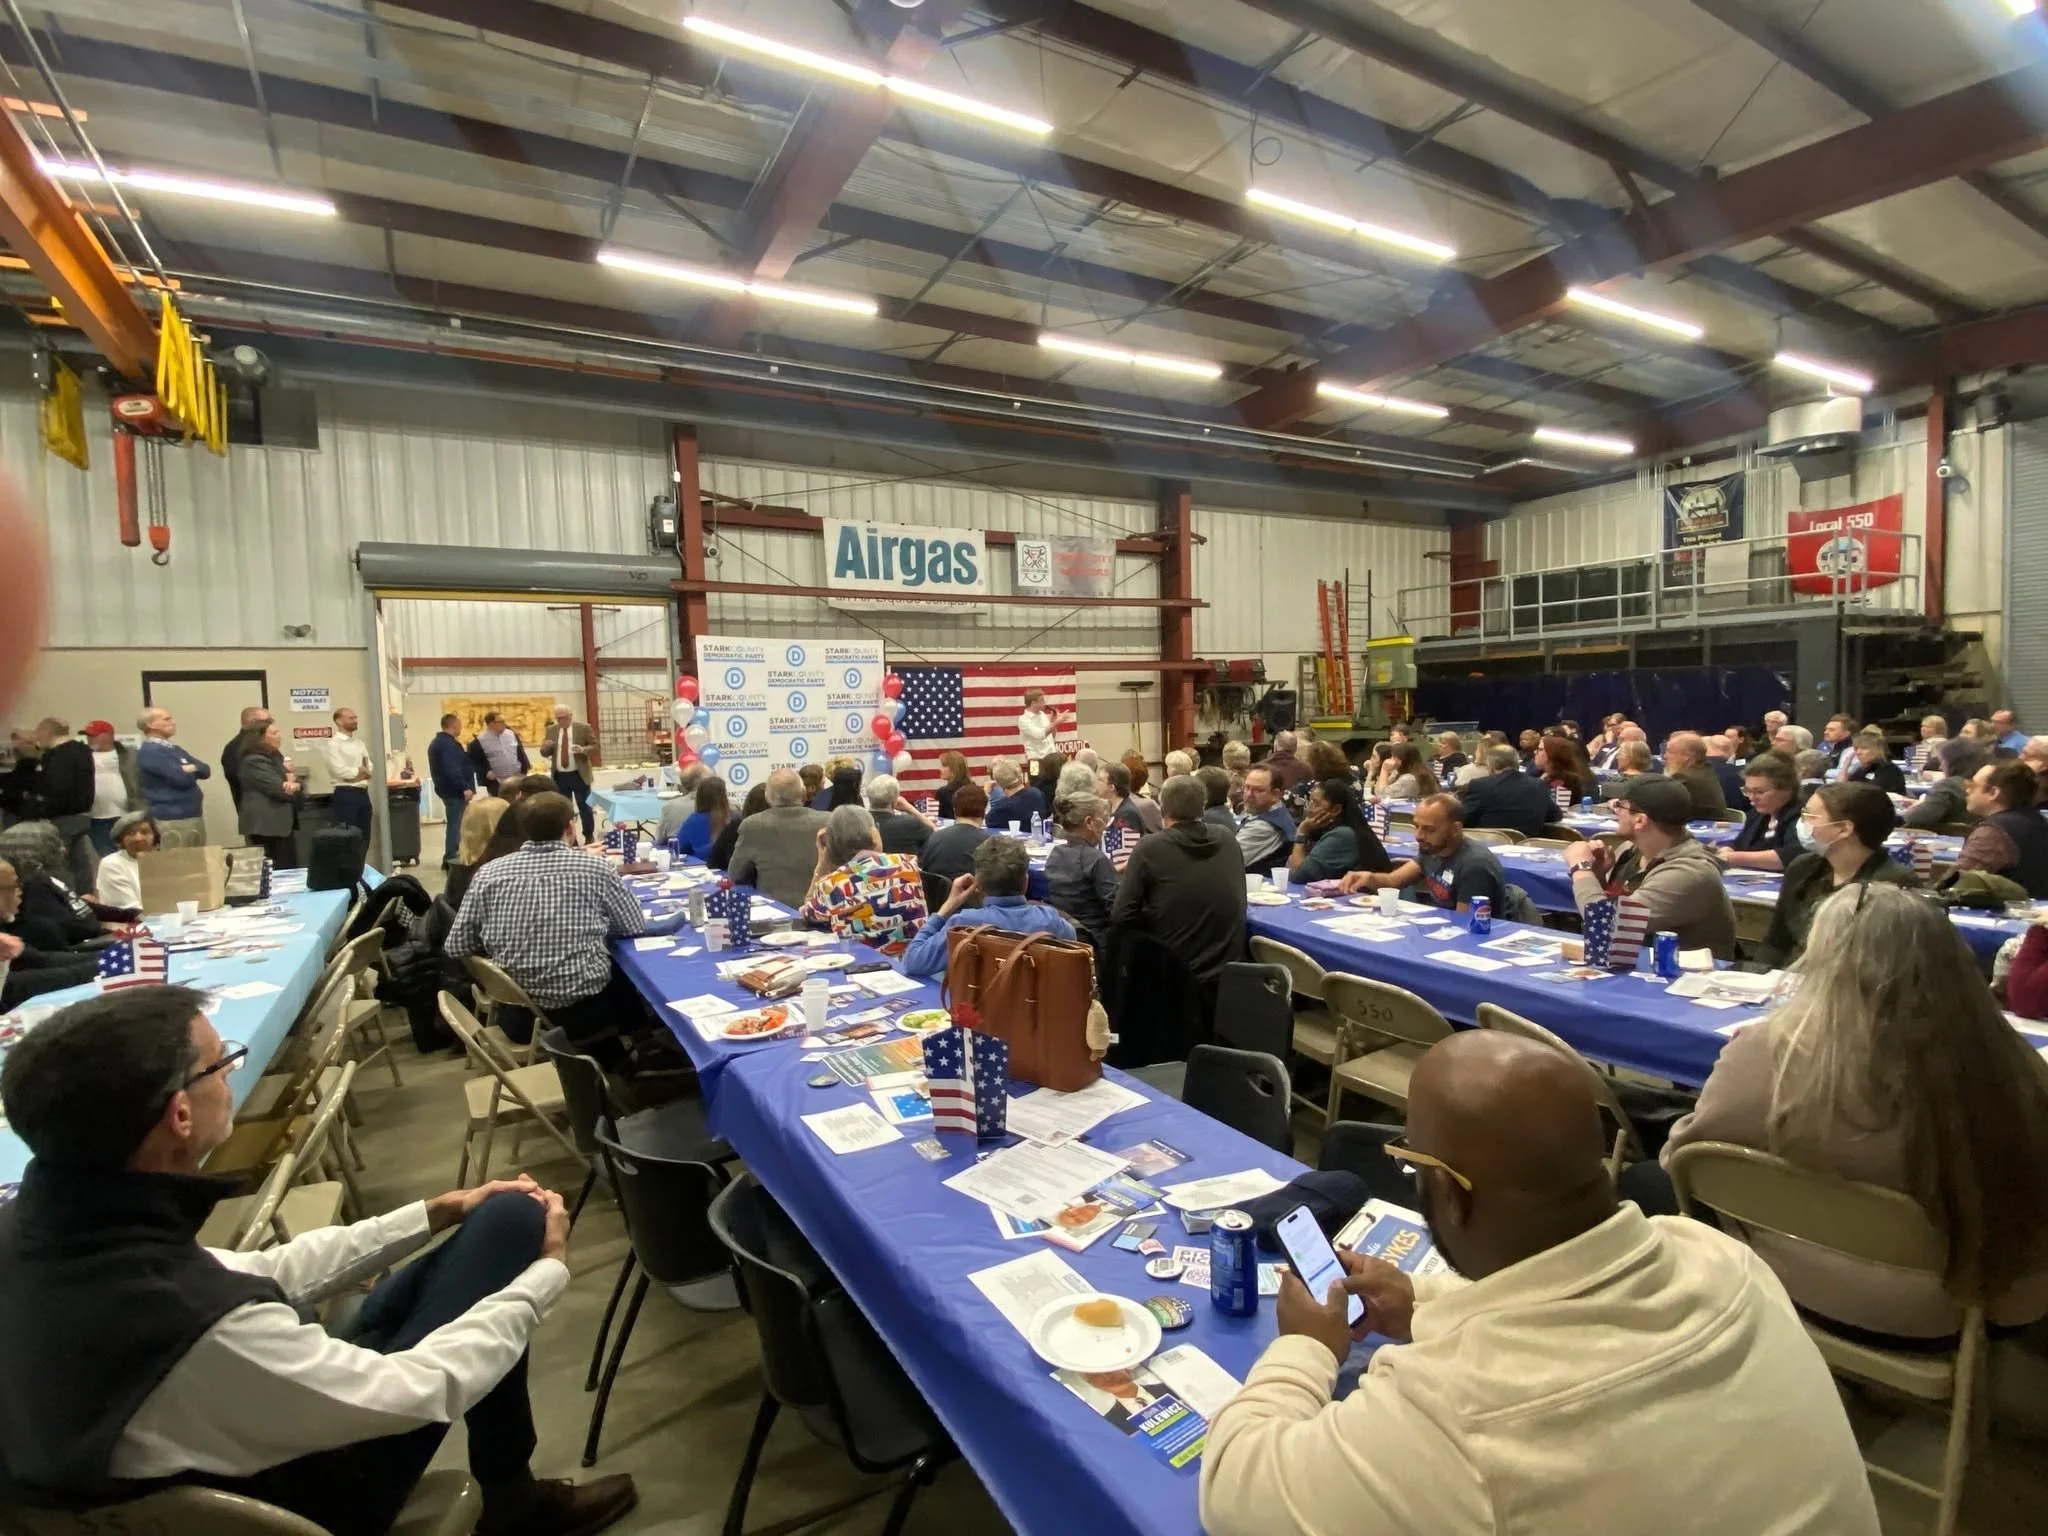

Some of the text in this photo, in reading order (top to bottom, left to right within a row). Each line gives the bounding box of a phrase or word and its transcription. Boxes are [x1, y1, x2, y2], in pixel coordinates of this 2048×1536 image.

[1809, 512, 1874, 532] Local 550
[835, 525, 978, 587] Airgas
[1358, 999, 1393, 1021] 550
[1138, 1402, 1183, 1432] KULEWICZ
